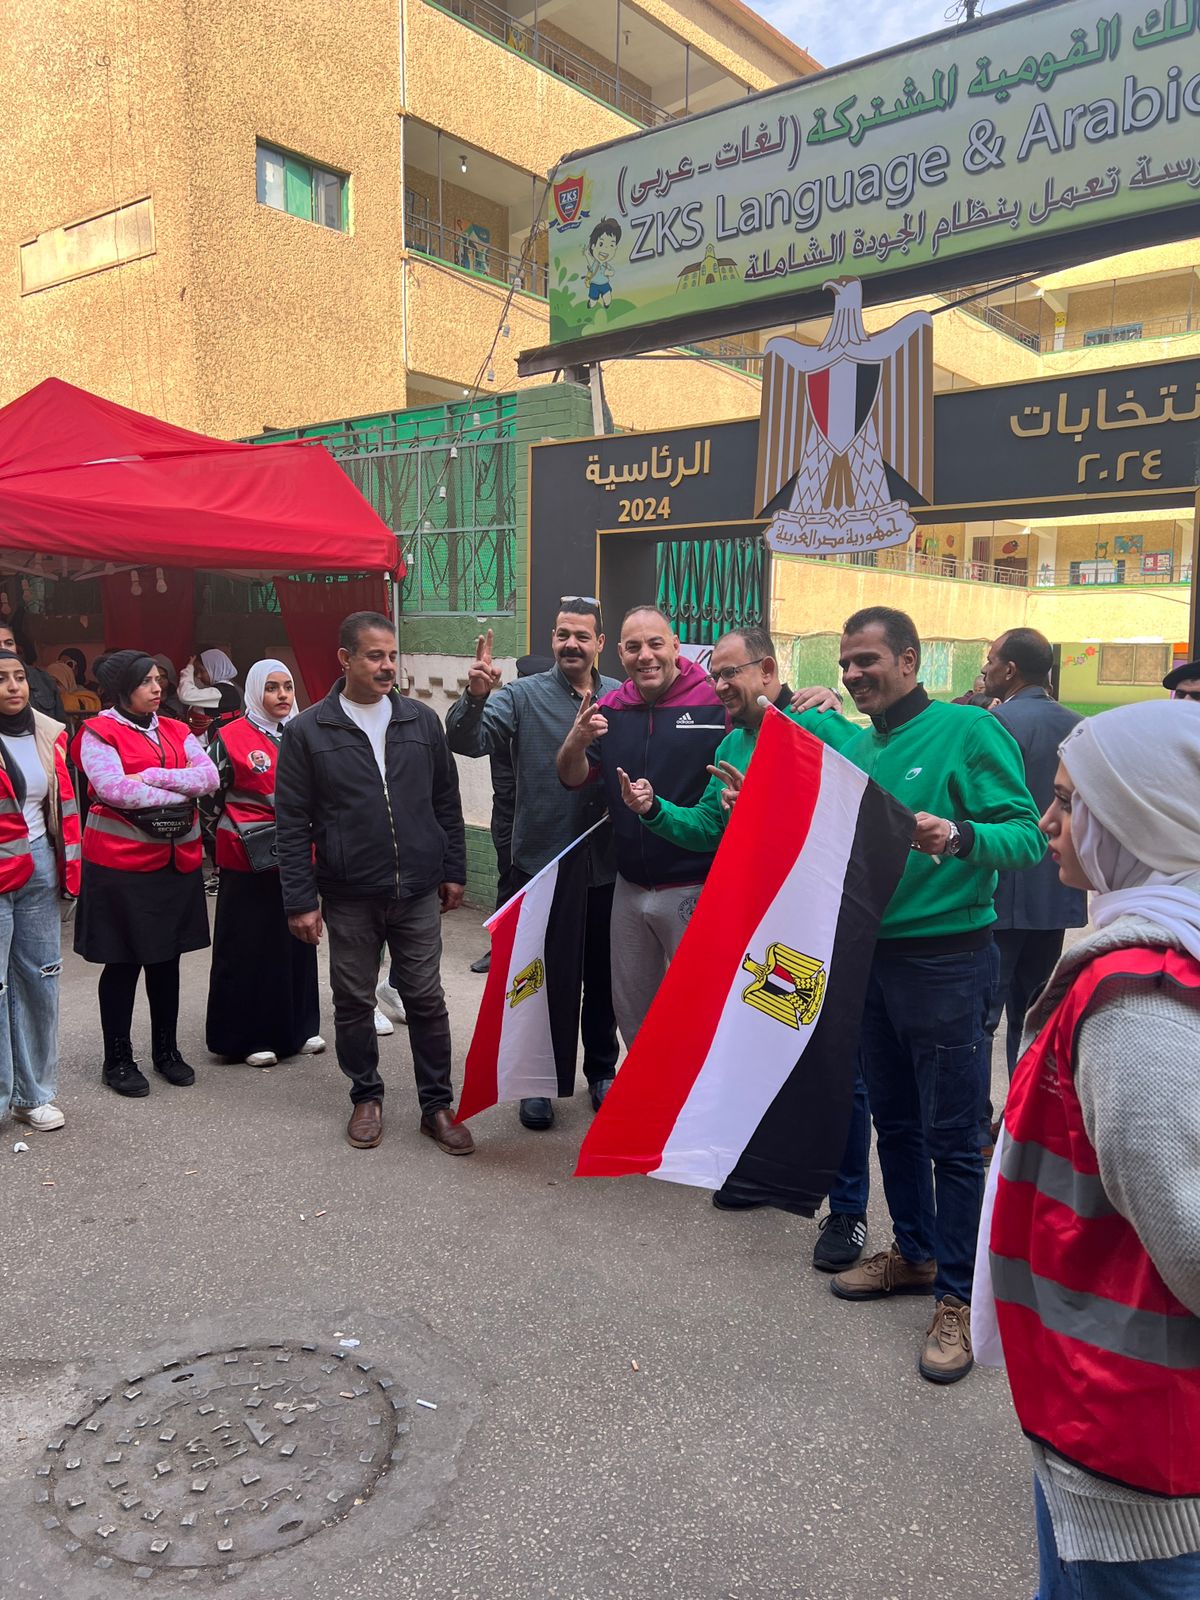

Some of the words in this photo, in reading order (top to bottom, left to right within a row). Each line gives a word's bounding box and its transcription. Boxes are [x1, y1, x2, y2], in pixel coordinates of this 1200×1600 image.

[968, 13, 1121, 101] القومية
[806, 63, 958, 145] المشتركة
[561, 190, 577, 203] ZKS
[629, 201, 704, 263] ZKS
[716, 144, 949, 241] Language
[963, 118, 1003, 173] &
[1029, 165, 1121, 223] تعمل
[852, 209, 926, 262] الجودة
[931, 197, 1021, 256] بنظام
[744, 230, 846, 282] الشاملة
[586, 439, 711, 490] الرئاسية
[1077, 449, 1163, 484] ٢٠٢٤
[618, 496, 671, 522] 2024
[846, 517, 903, 546] جمهورية
[775, 524, 817, 548] العربية
[814, 534, 845, 550] مصر
